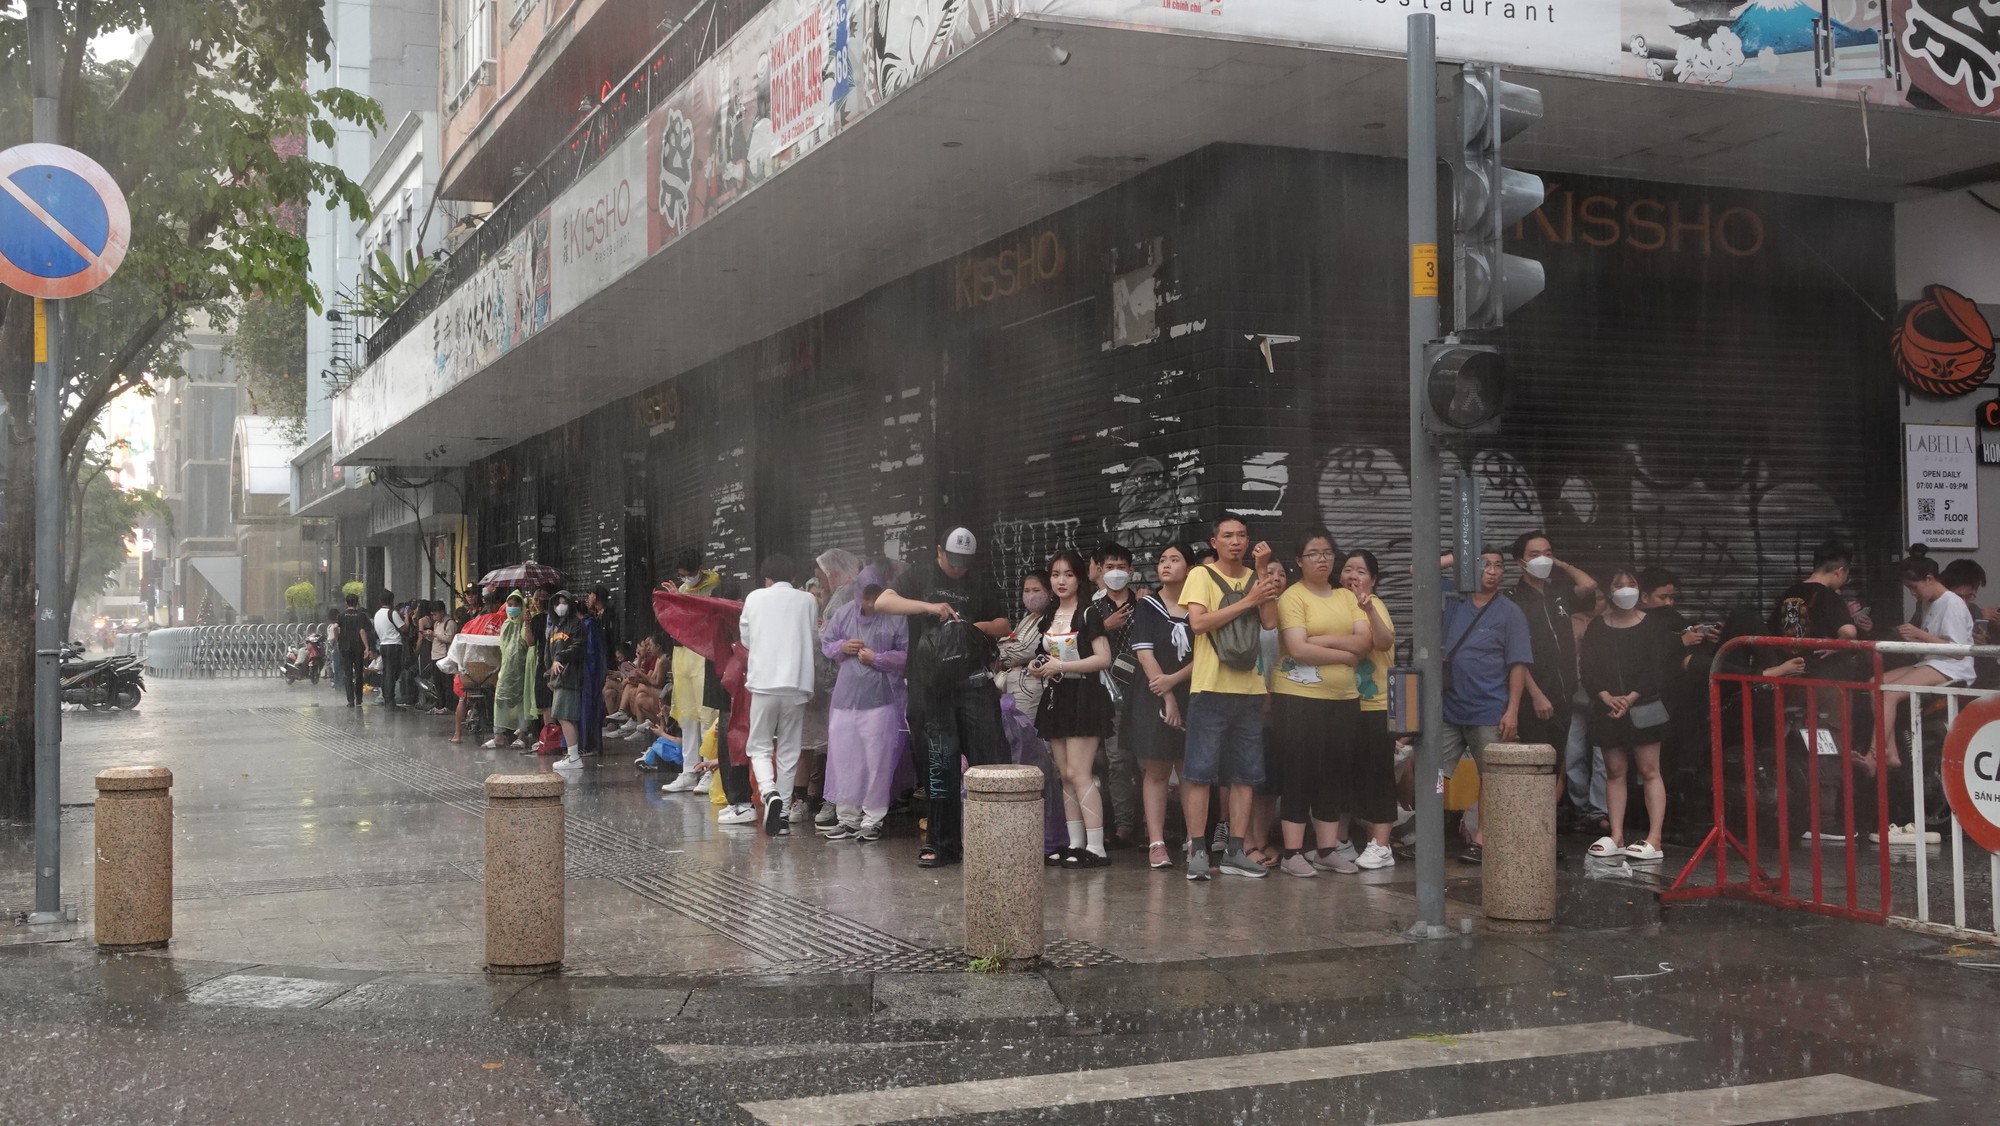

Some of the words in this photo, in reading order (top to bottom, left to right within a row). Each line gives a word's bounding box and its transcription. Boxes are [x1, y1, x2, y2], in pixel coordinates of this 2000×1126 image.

[570, 178, 630, 264] KISSHO
[1511, 183, 1764, 257] KISSHO
[955, 230, 1062, 312] KISSHO
[1426, 261, 1435, 278] 3
[1909, 434, 1973, 454] LABELLA
[1922, 470, 1941, 478] OPEN
[1934, 482, 1944, 490] AM
[1944, 513, 1968, 522] FLOOR
[1974, 791, 1992, 801] BÁN
